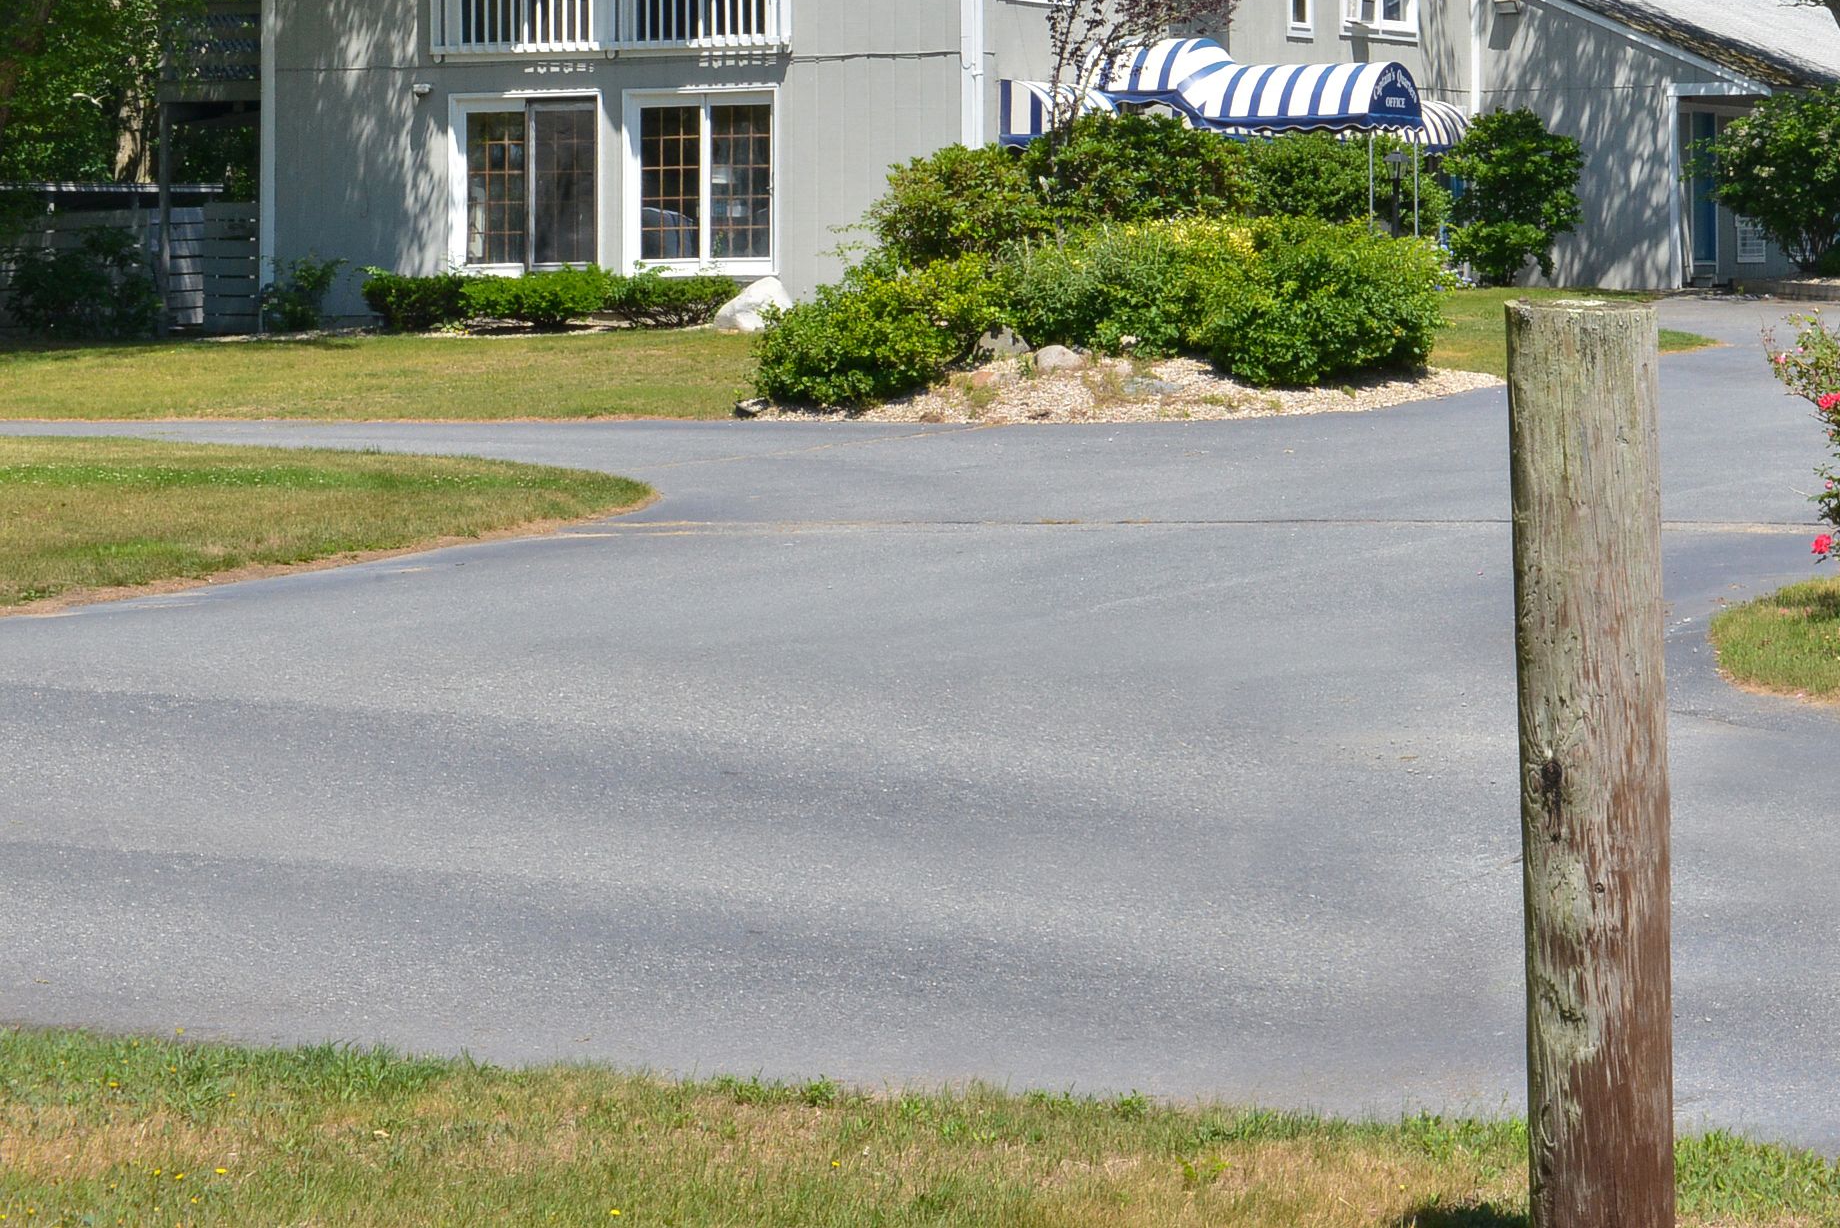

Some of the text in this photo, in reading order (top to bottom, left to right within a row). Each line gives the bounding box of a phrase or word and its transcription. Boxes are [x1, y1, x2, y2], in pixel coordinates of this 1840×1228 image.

[1373, 67, 1417, 103] Captain's Quarters
[1385, 96, 1406, 108] OFFICE
